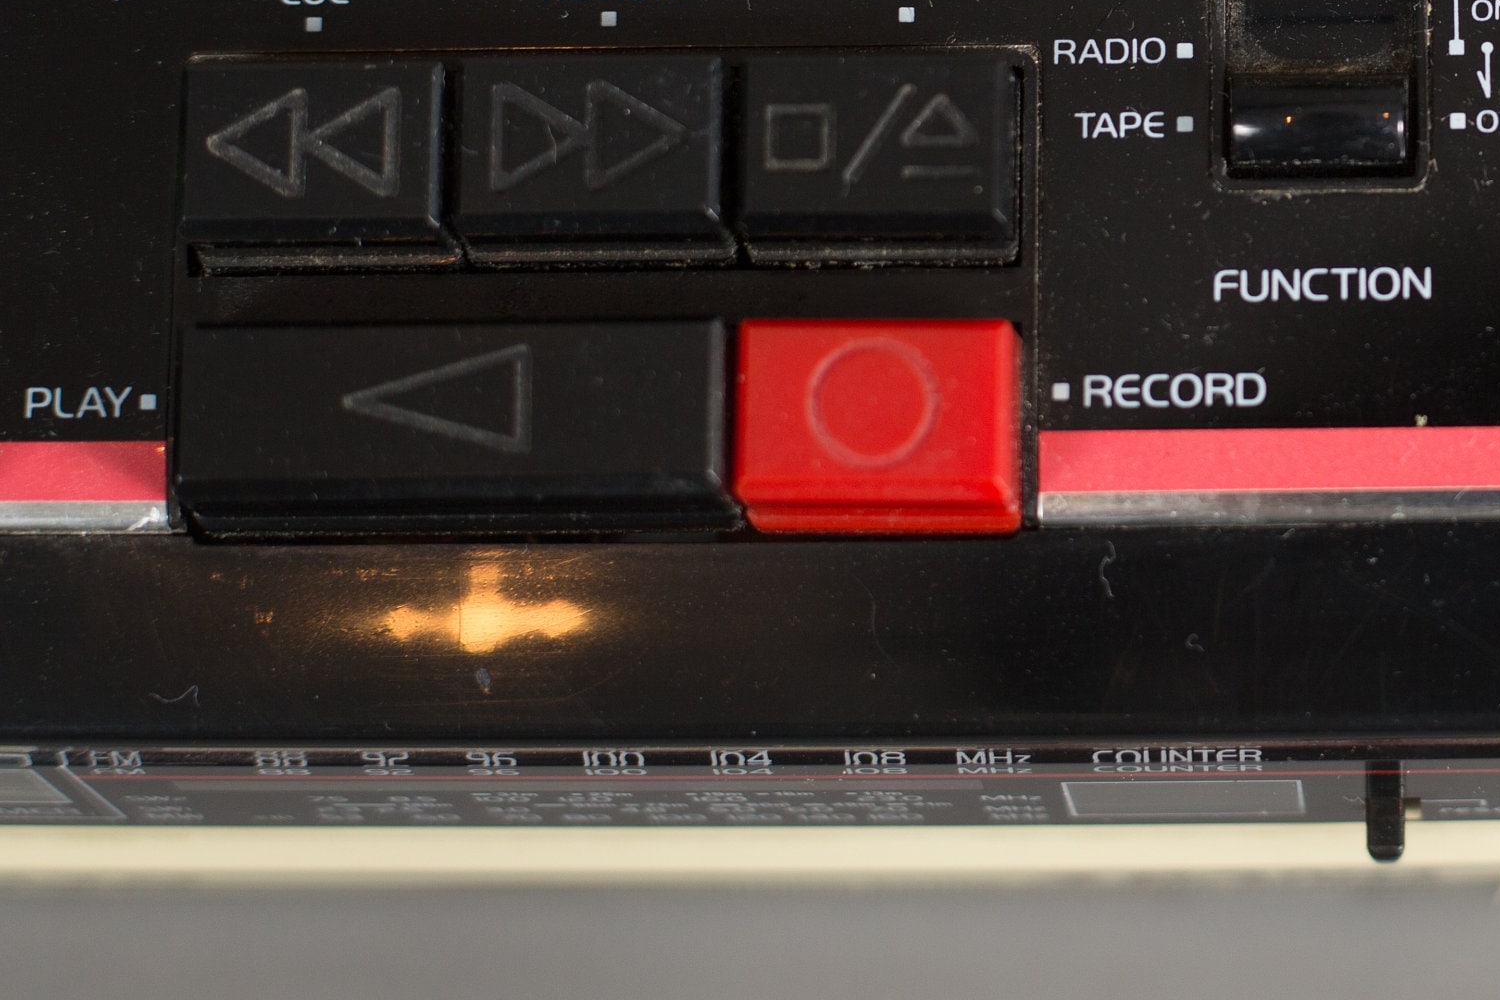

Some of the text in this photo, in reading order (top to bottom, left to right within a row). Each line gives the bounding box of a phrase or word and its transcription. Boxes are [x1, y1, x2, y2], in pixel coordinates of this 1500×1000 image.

[1053, 36, 1166, 65] RADIO
[1074, 111, 1165, 139] TAPE
[1213, 266, 1432, 303] FUNCTION
[25, 386, 132, 418] PLAY
[1083, 372, 1267, 408] RECORD
